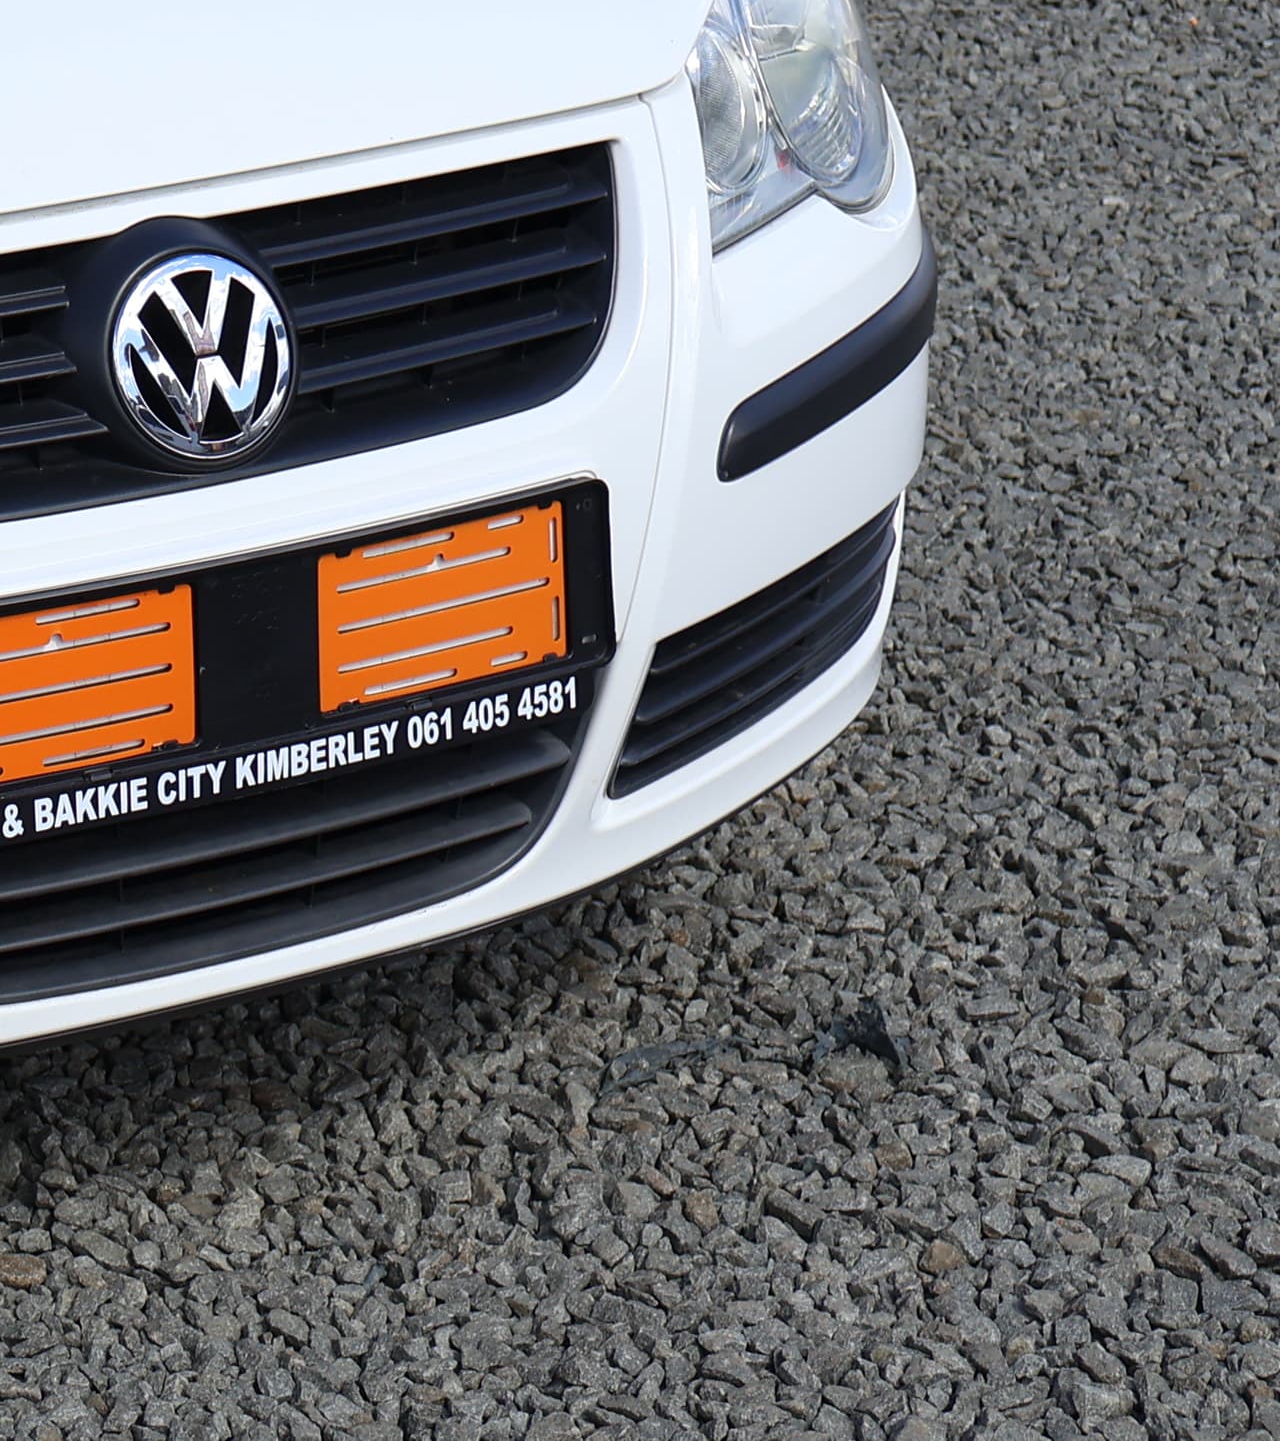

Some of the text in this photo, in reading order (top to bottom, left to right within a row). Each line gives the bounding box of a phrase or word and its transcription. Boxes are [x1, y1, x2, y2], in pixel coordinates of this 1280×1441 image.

[112, 253, 290, 459] VW
[2, 803, 25, 839] &
[34, 777, 149, 833] BAKKIE
[157, 760, 227, 806] CITY
[235, 720, 399, 789] KIMBERLEY
[407, 707, 453, 749] 061
[462, 693, 510, 734] 405
[517, 676, 578, 720] 4581
